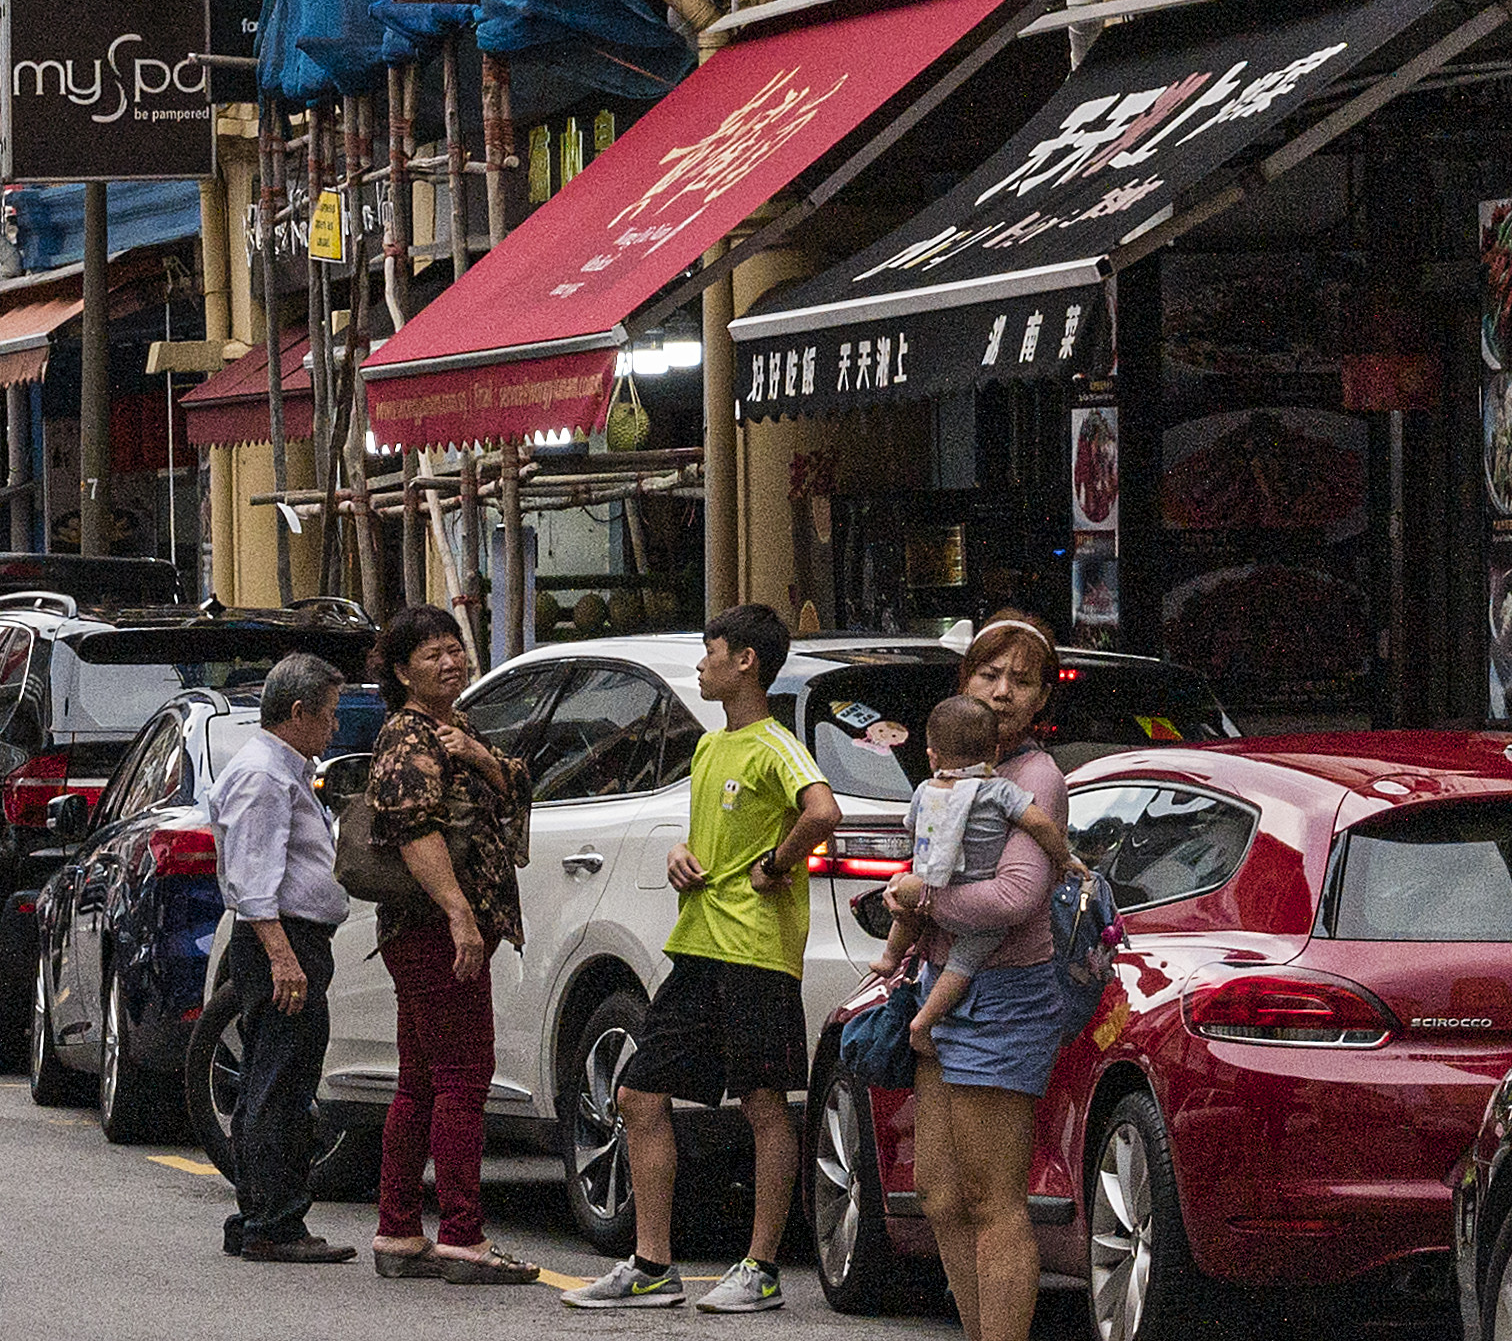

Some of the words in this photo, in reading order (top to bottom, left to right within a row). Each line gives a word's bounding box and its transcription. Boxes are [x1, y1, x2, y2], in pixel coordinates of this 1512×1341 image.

[134, 105, 151, 120] be
[154, 106, 210, 124] pampered
[87, 478, 98, 500] 7
[1410, 1017, 1493, 1029] SCIROCCO
